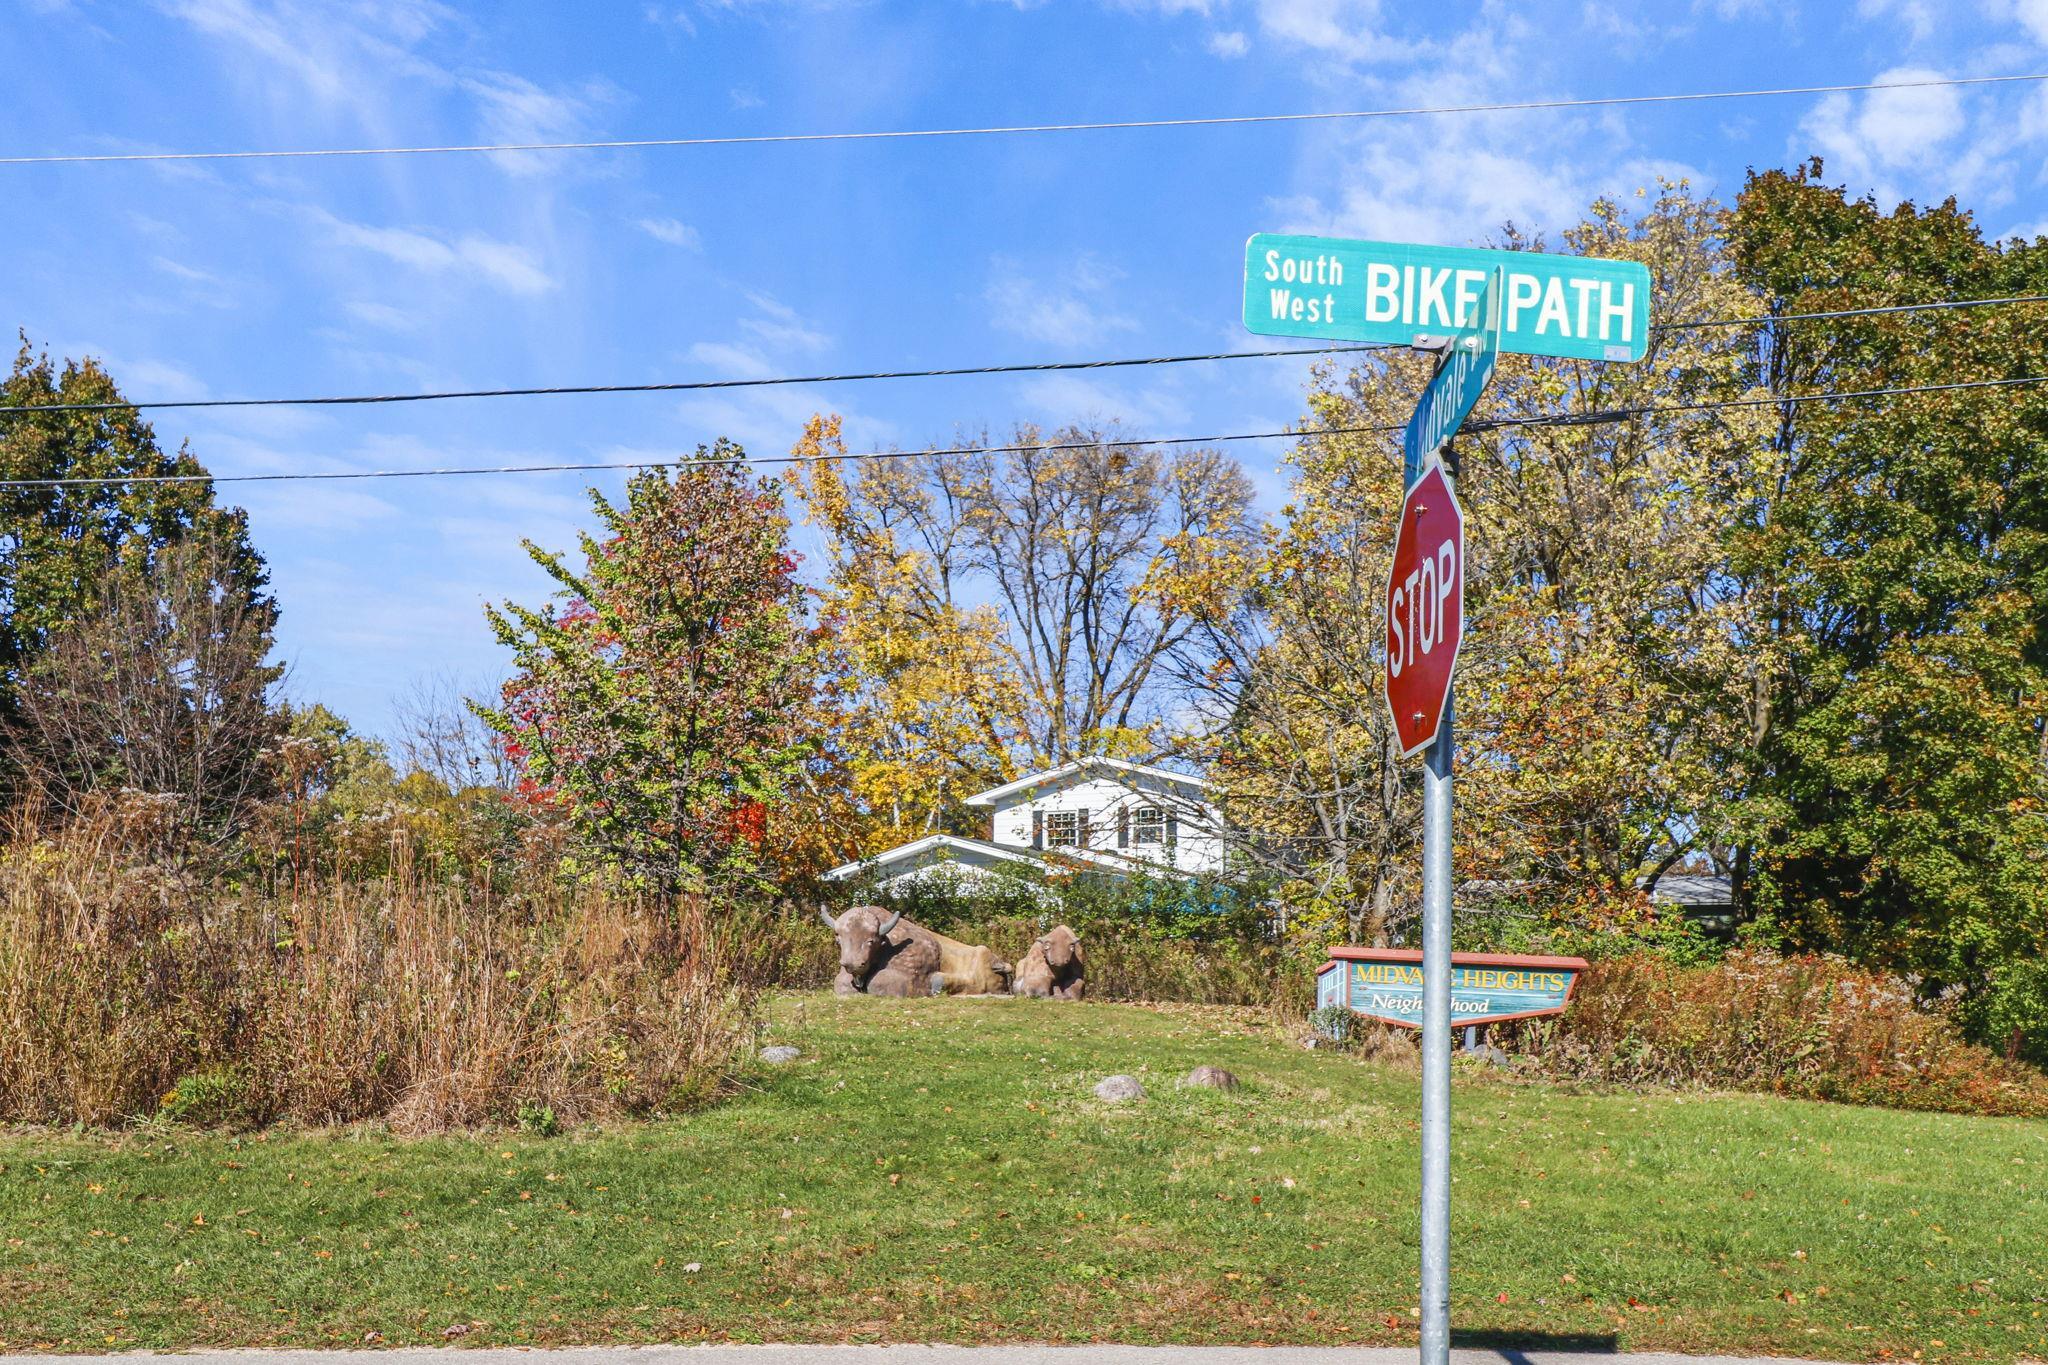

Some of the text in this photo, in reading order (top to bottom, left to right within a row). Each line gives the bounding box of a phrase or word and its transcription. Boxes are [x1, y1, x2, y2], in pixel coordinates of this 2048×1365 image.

[1265, 249, 1343, 286] South
[1270, 288, 1335, 323] West
[1365, 262, 1634, 342] BIKE PATH
[1390, 539, 1456, 678] STOP
[1356, 964, 1564, 992] MIDVA HEIGHTS
[1371, 993, 1489, 1014] Neighhood
